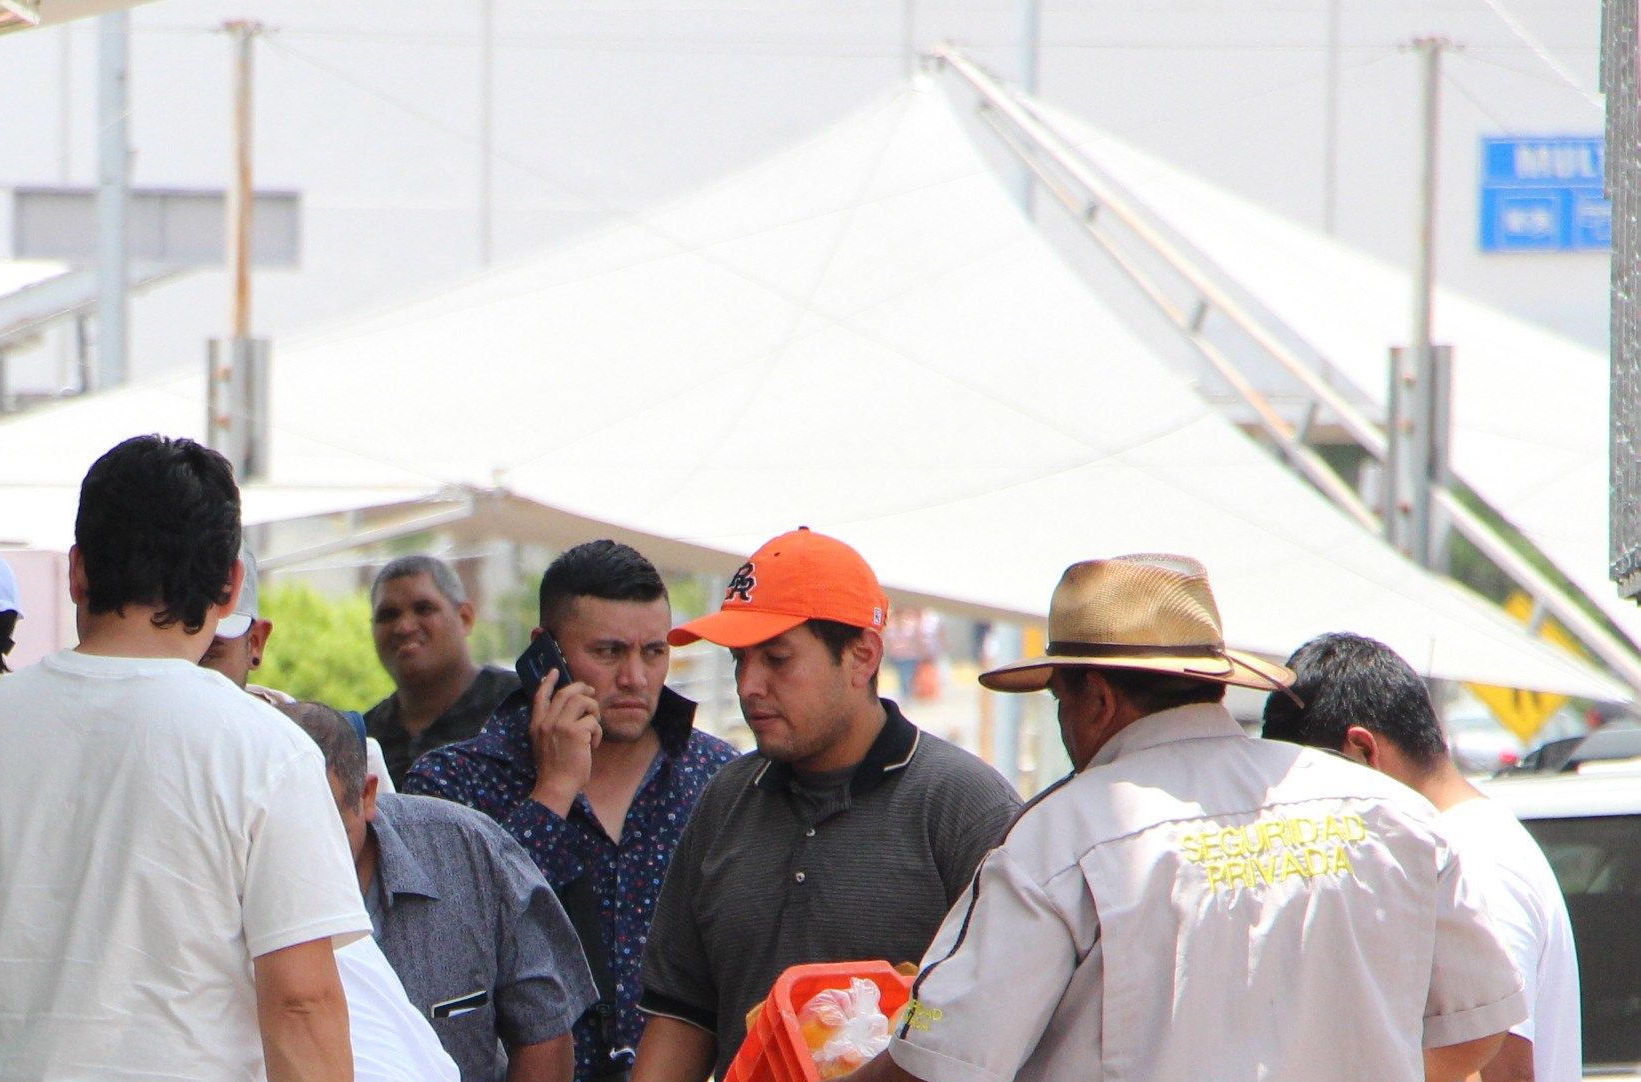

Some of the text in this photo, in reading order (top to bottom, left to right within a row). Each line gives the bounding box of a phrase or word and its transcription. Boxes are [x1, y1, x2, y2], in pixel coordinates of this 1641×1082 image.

[1516, 146, 1605, 179] MUL
[1180, 815, 1367, 862] SEGURIDAD
[1206, 847, 1354, 892] PRIVADA
